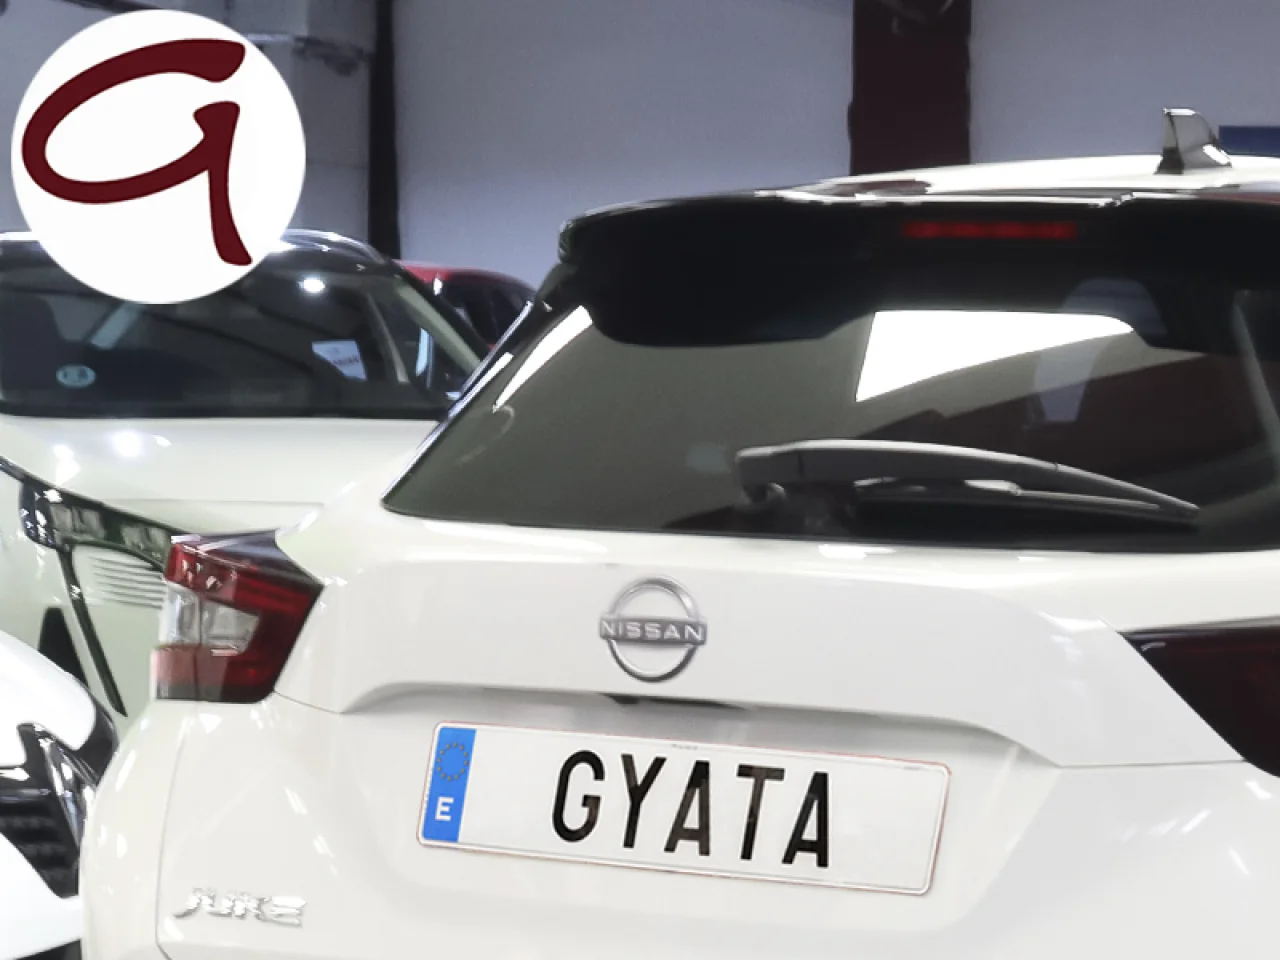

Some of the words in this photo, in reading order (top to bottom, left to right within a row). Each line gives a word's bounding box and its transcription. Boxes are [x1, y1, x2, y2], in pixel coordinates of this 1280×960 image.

[600, 619, 705, 642] NISSAN
[433, 797, 454, 822] E
[552, 750, 830, 868] GYATA
